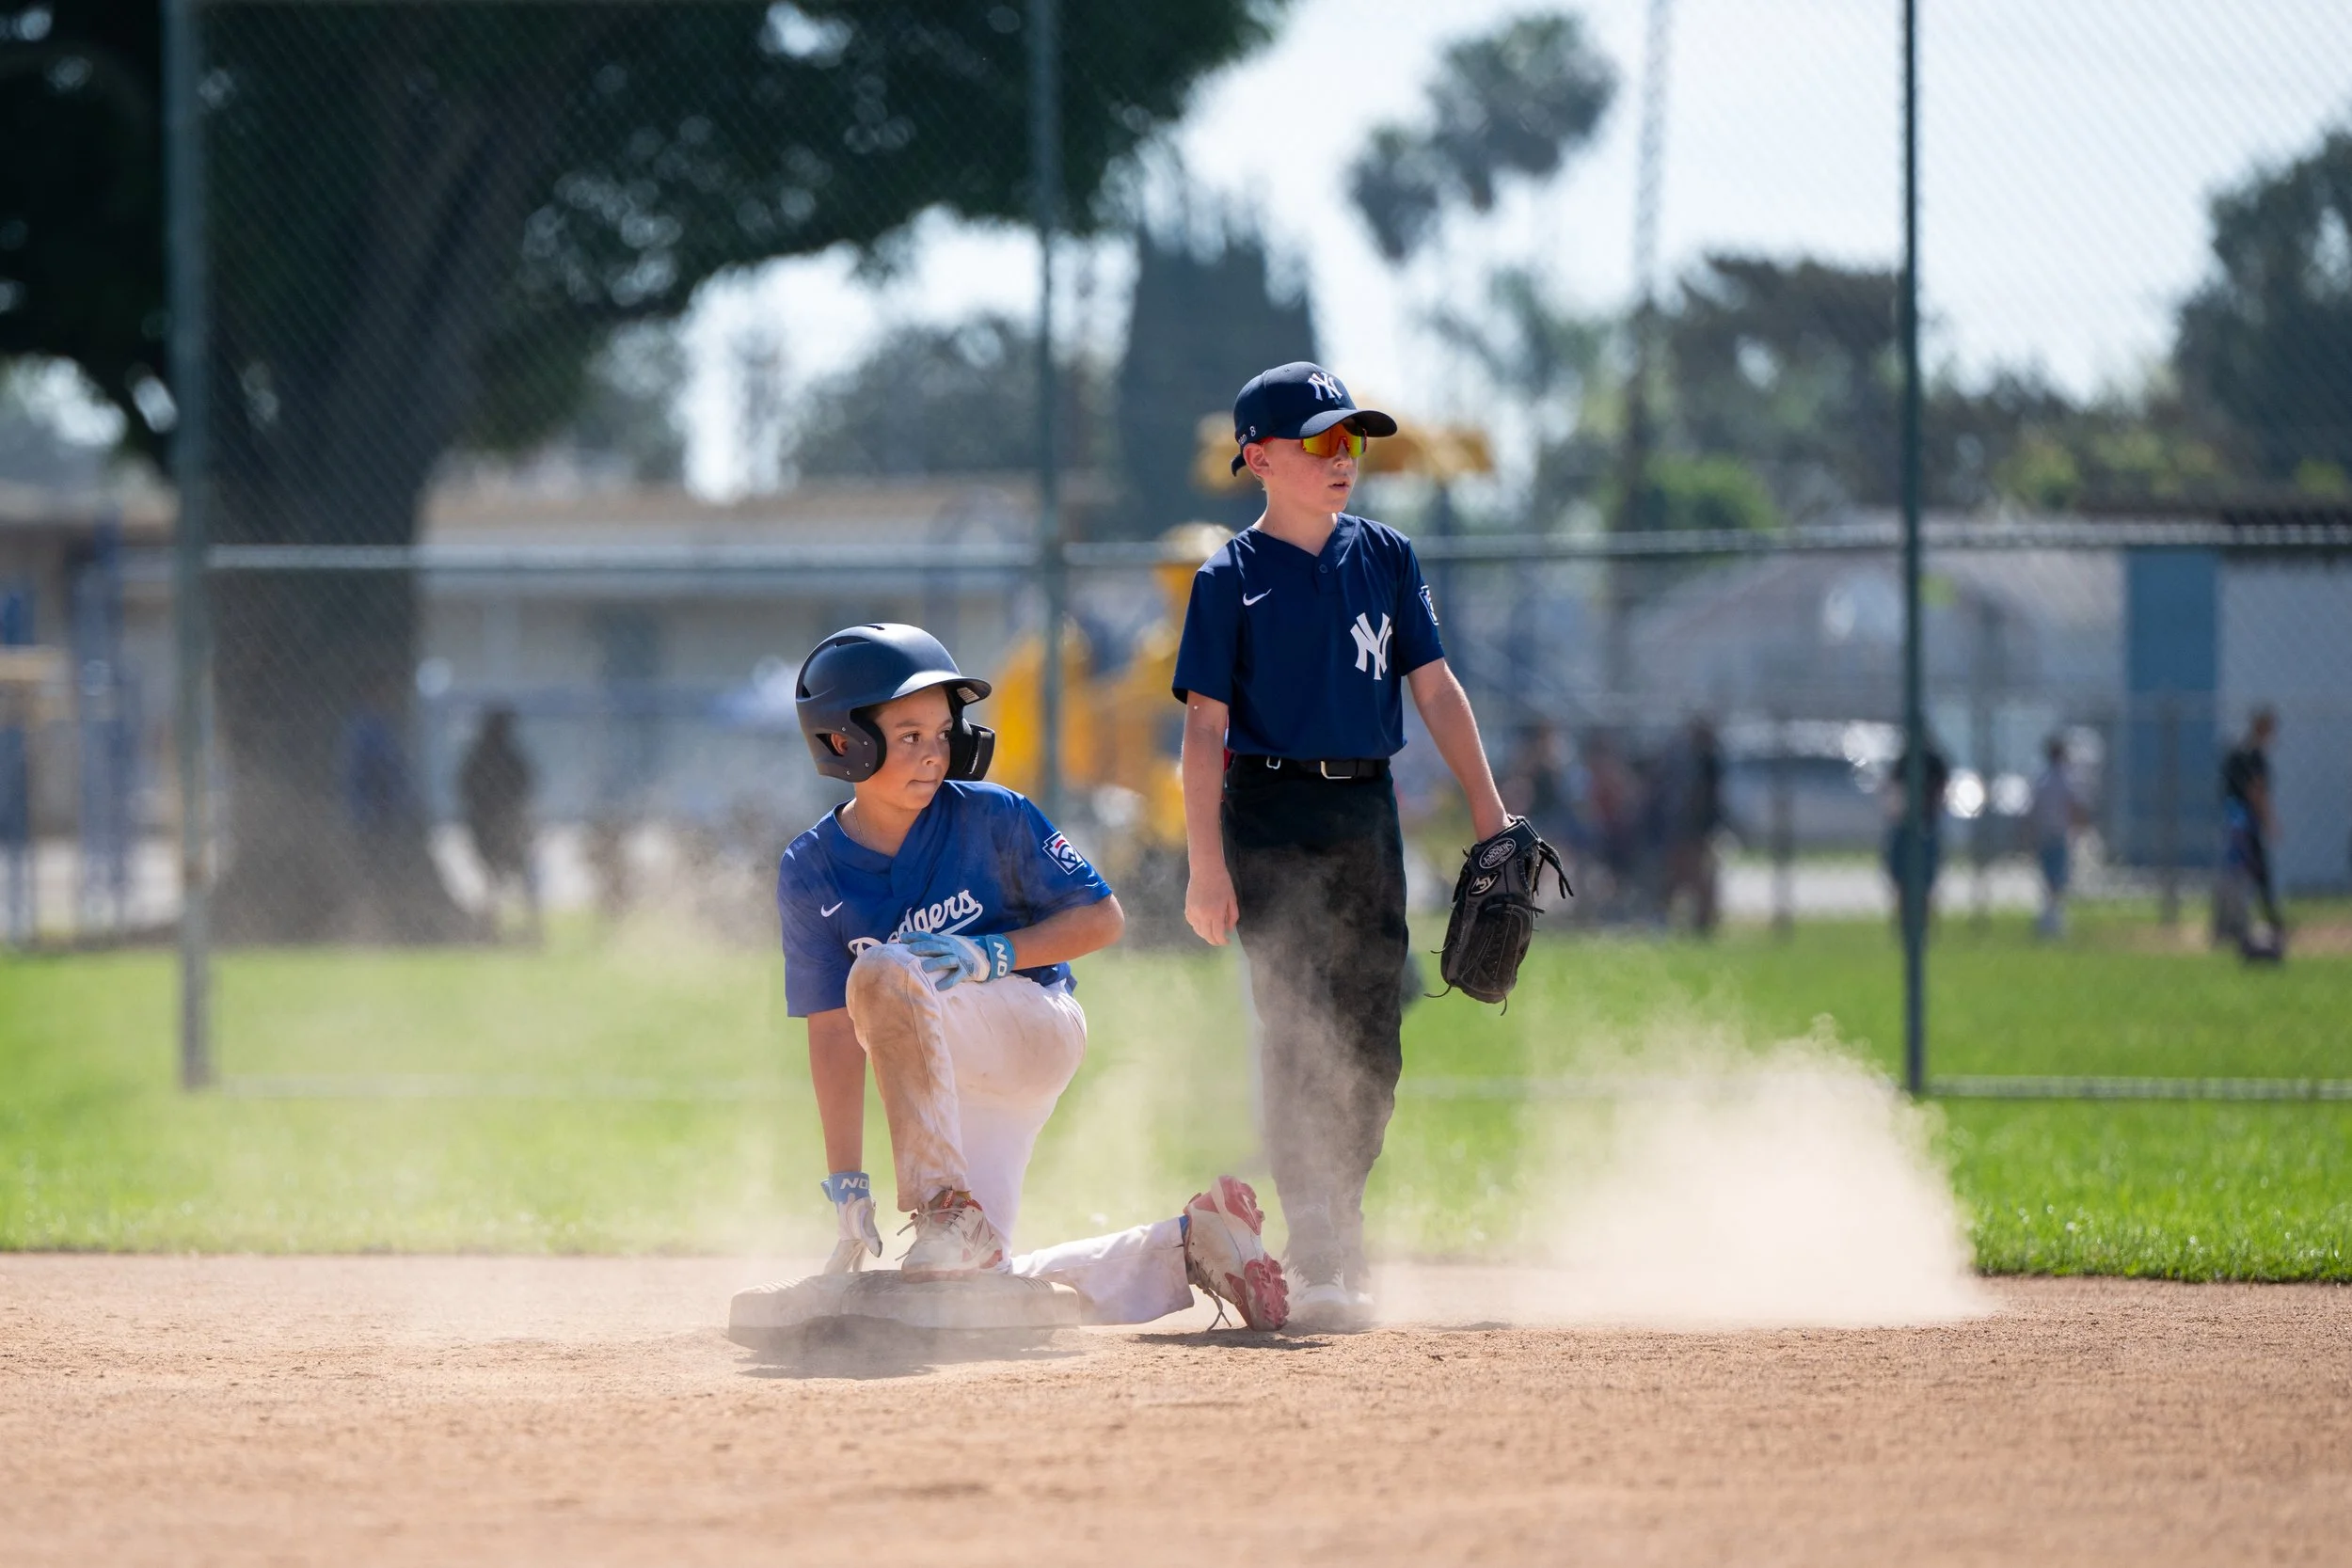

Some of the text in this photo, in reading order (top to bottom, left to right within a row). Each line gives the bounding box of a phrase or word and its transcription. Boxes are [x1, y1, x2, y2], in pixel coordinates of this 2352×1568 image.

[1308, 372, 1343, 401] NY
[1249, 425, 1256, 436] 8
[1350, 611, 1393, 681] NY
[1483, 839, 1514, 863] Slugger
